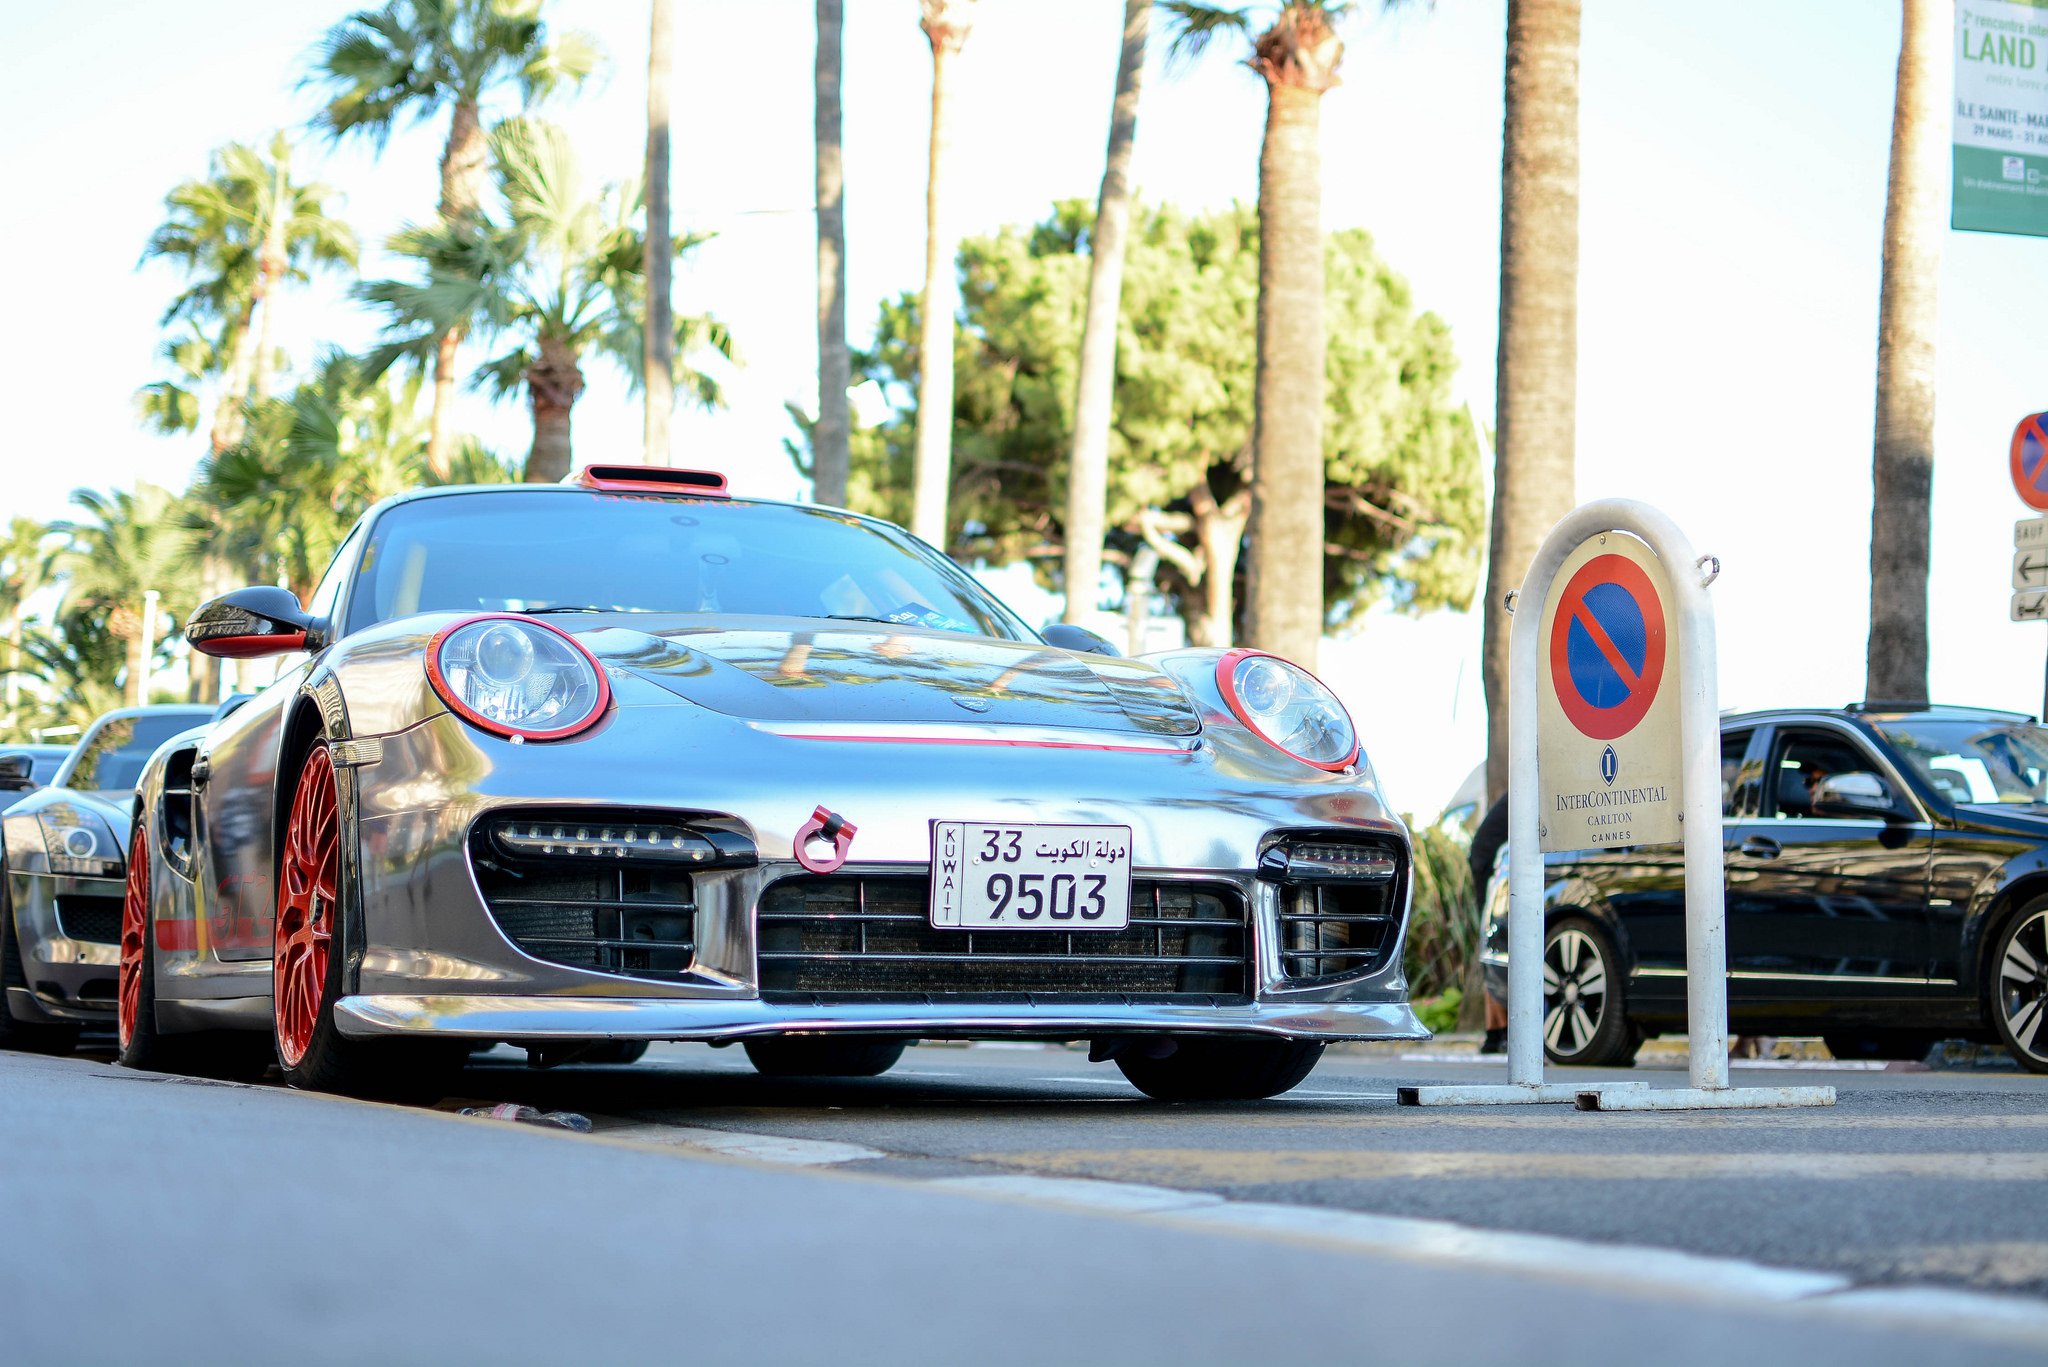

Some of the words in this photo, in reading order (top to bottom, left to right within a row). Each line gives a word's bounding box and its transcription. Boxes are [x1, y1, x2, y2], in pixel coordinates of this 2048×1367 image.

[1975, 15, 2025, 34] rencontre
[2028, 21, 2048, 37] inte
[1963, 28, 2036, 69] LAND
[1987, 128, 2013, 140] MARS
[2025, 131, 2034, 144] 31
[2038, 133, 2048, 145] AO
[1557, 786, 1667, 811] INTERCONTINENTAL
[1587, 812, 1632, 826] CARLTON
[980, 829, 1023, 862] 33
[1591, 830, 1631, 842] CANNES
[1035, 839, 1090, 863] الكويت
[1095, 840, 1125, 863] دولة
[942, 828, 957, 921] KUWAIT
[986, 873, 1107, 920] 9503
